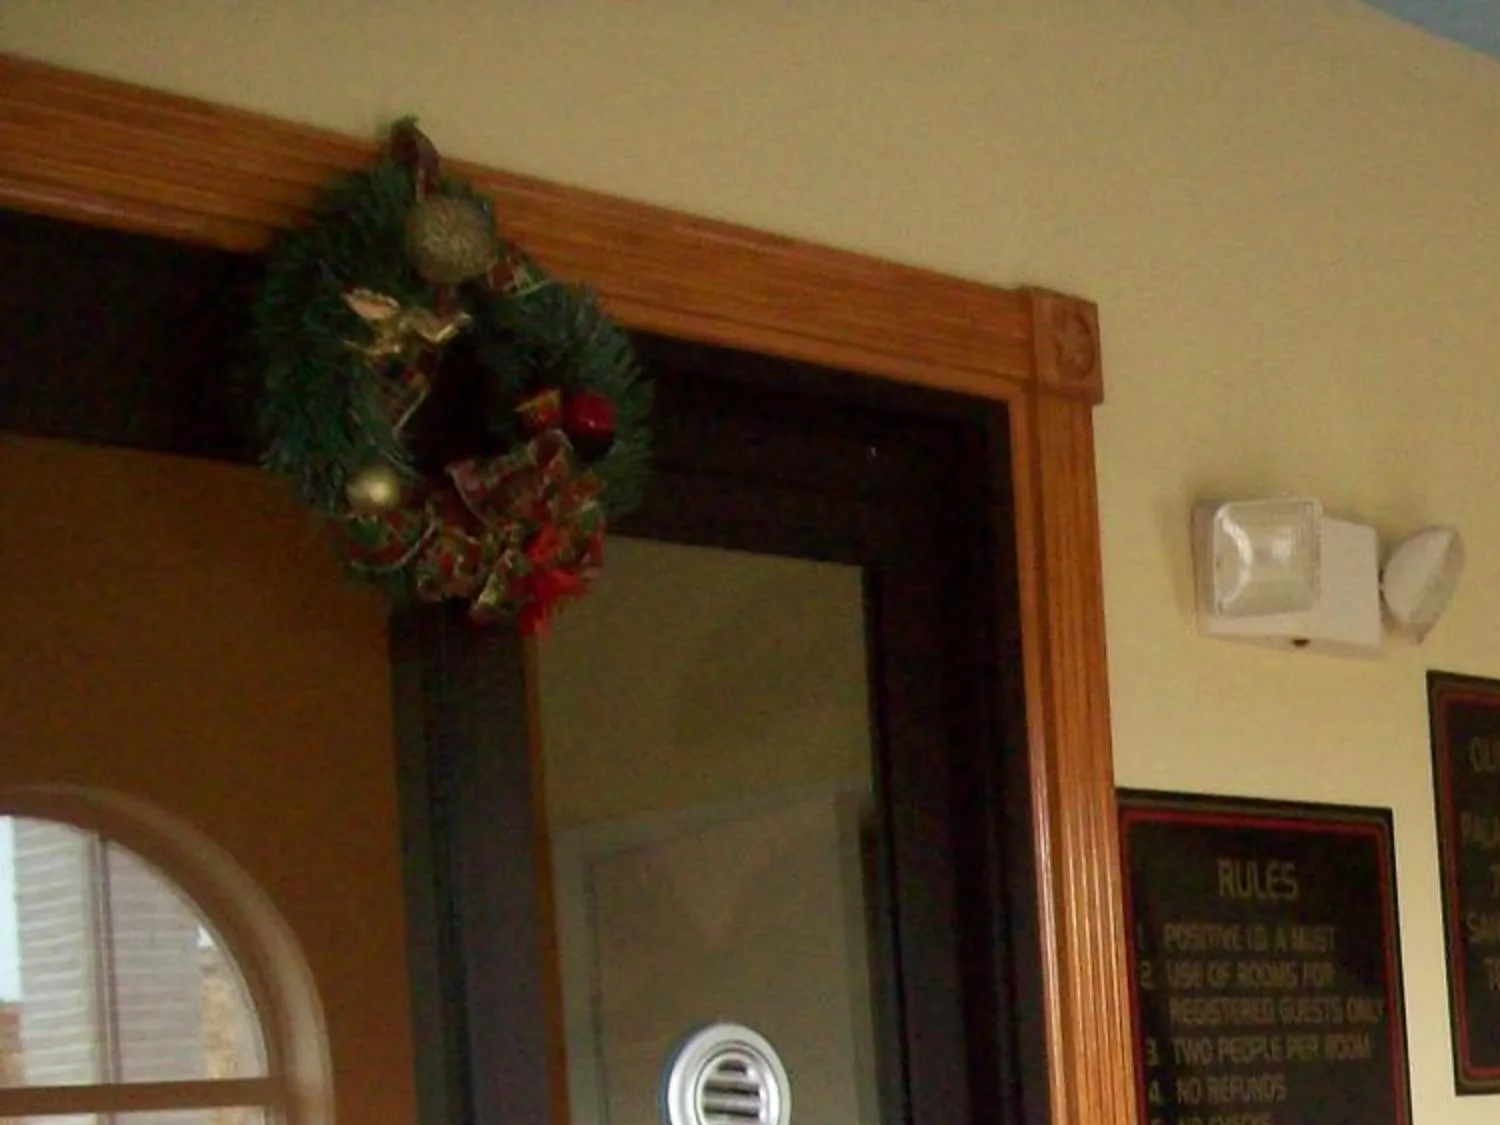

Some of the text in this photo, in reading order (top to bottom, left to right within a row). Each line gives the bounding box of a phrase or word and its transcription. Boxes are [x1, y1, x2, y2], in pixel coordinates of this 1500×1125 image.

[1217, 856, 1298, 900] RULES
[1173, 1035, 1214, 1067] TWO
[1217, 1034, 1283, 1065] PEOPLE
[1175, 1076, 1202, 1105] NO
